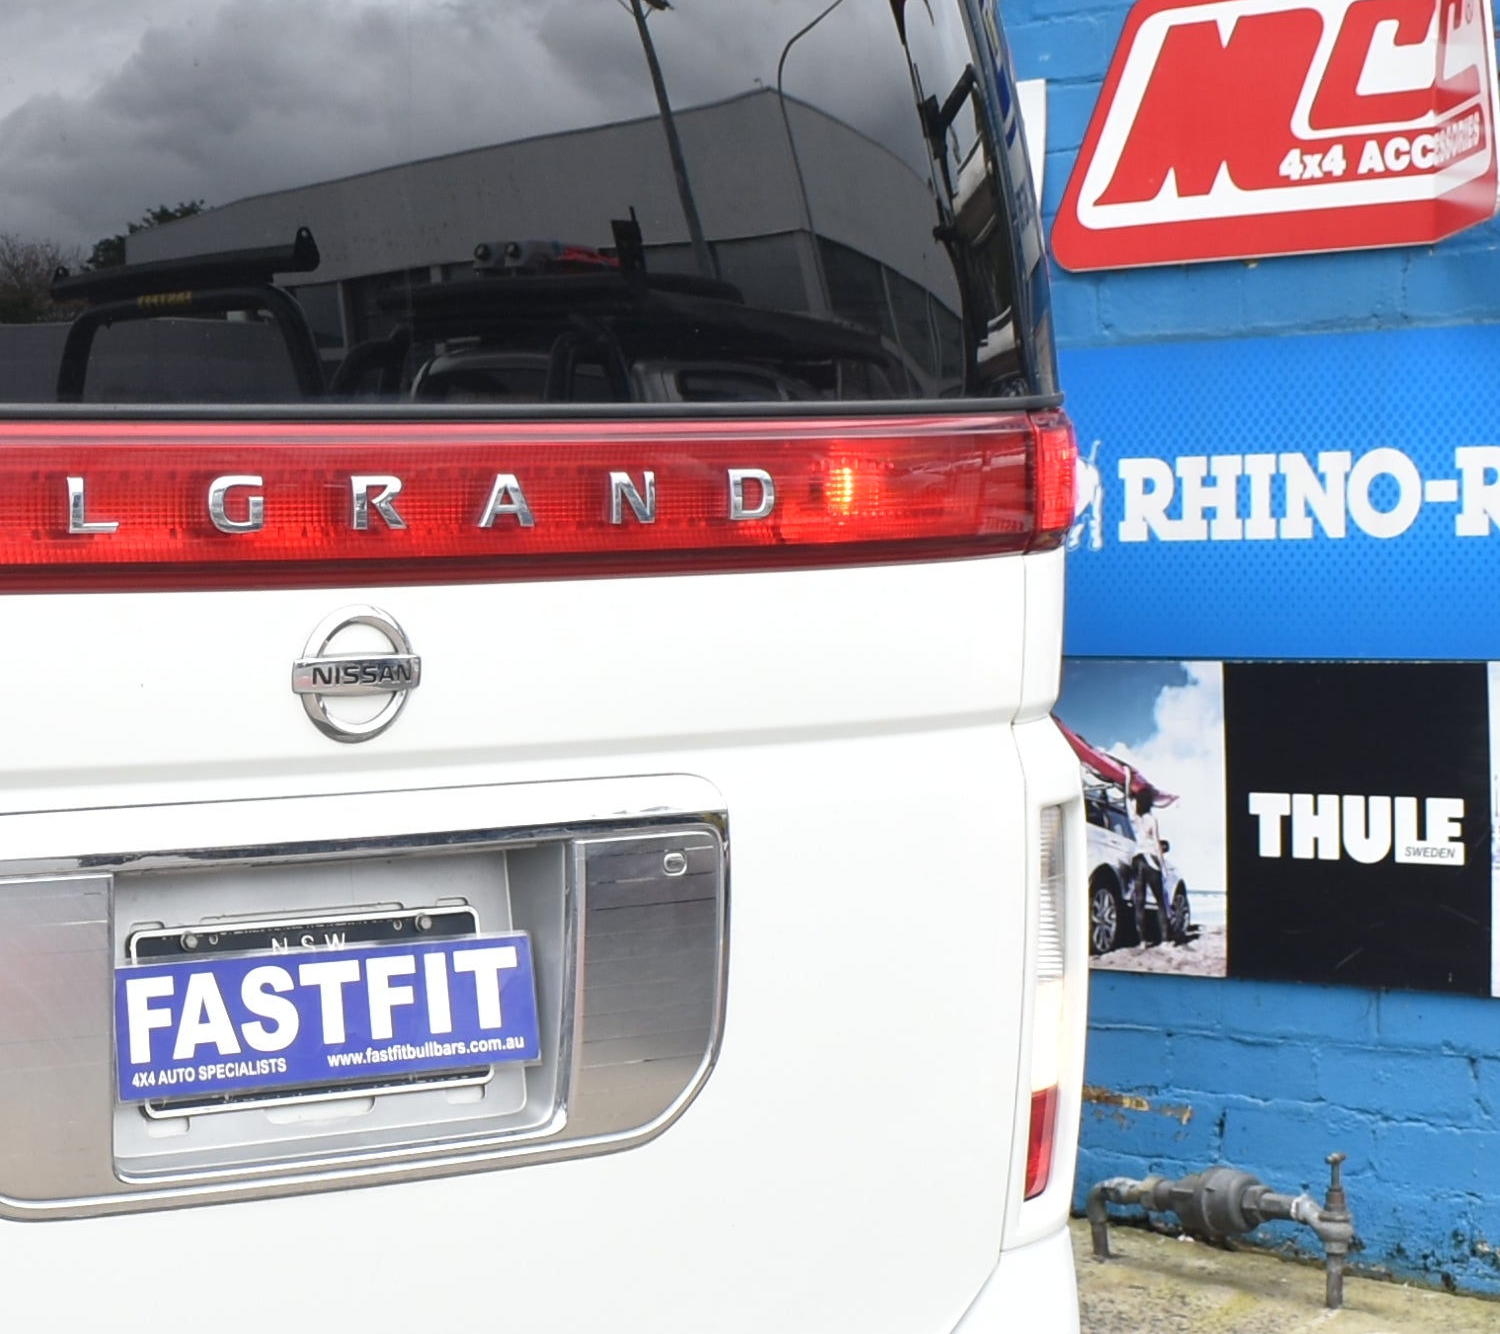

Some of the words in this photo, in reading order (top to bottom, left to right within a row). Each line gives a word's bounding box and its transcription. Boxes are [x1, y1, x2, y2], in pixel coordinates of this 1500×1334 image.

[1279, 143, 1347, 181] 4x4
[311, 663, 414, 689] NISSAN
[1247, 791, 1466, 867] THULE
[1403, 844, 1457, 860] SWEDEN
[125, 945, 518, 1065] FASTFIT
[327, 1033, 525, 1069] www.fastfitbullbars.com.au
[131, 1071, 156, 1089] 4X4
[158, 1067, 196, 1086] AUTO
[198, 1057, 287, 1081] SPECIALISTS
